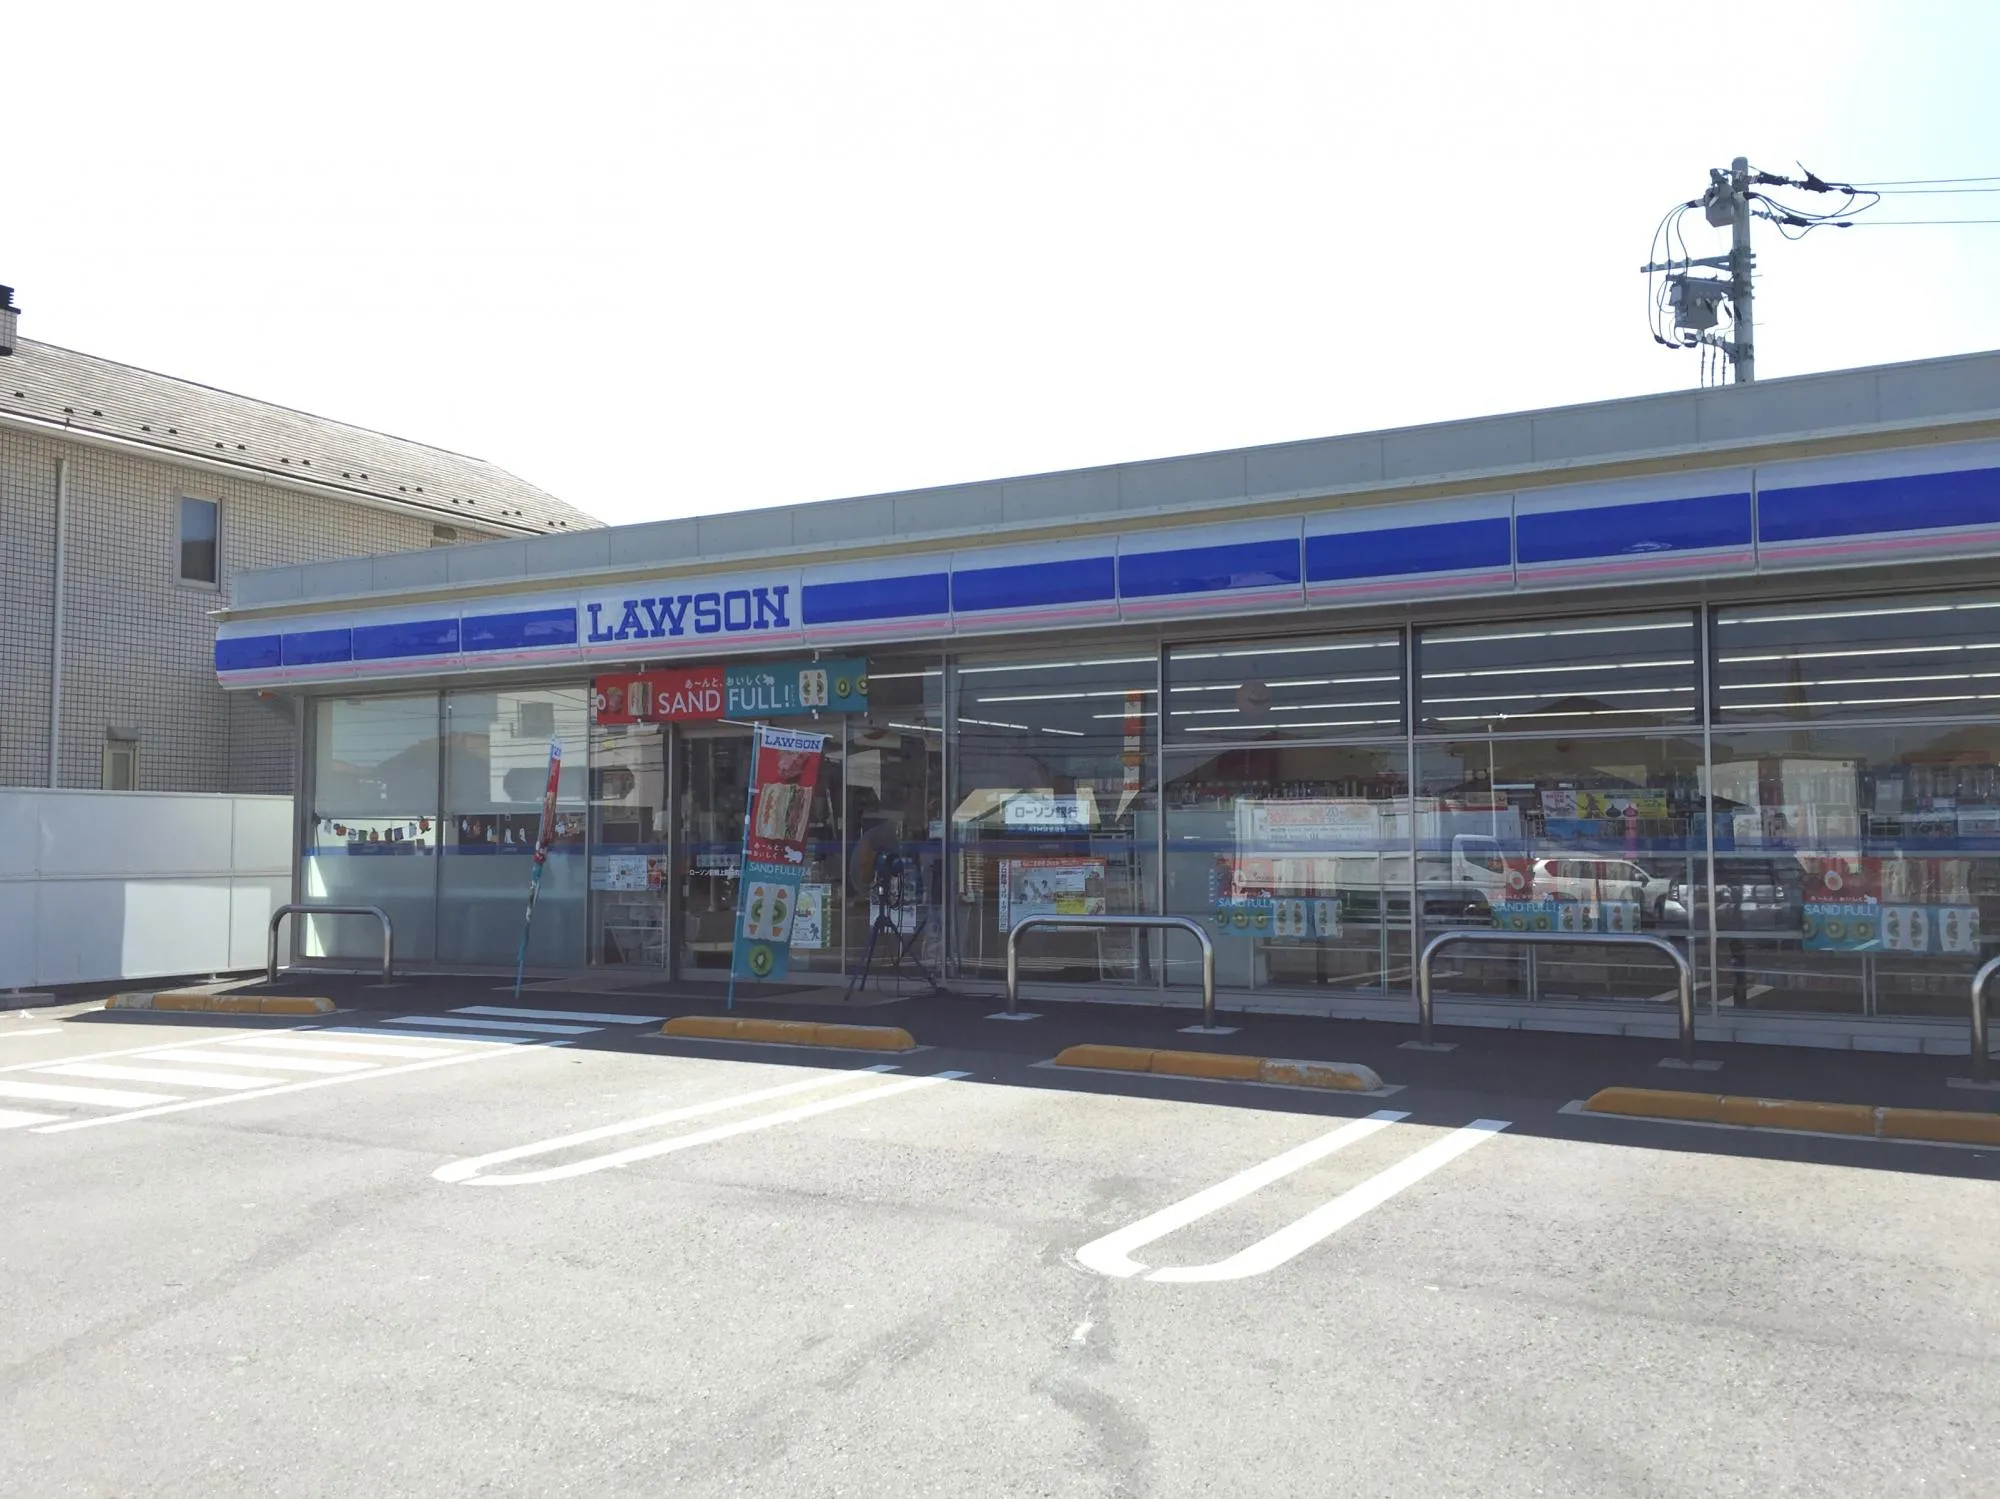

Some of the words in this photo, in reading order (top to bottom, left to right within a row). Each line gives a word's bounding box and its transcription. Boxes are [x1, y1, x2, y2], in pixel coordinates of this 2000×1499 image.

[587, 586, 790, 643] LAWSON
[726, 674, 762, 687] おいしく
[658, 688, 721, 715] SAND
[728, 685, 790, 711] FULL!
[765, 736, 821, 750] LAWSON
[1015, 806, 1079, 819] ローソン銀行
[749, 862, 774, 875] SAND
[1492, 902, 1524, 913] SAND
[1804, 903, 1841, 916] SAND
